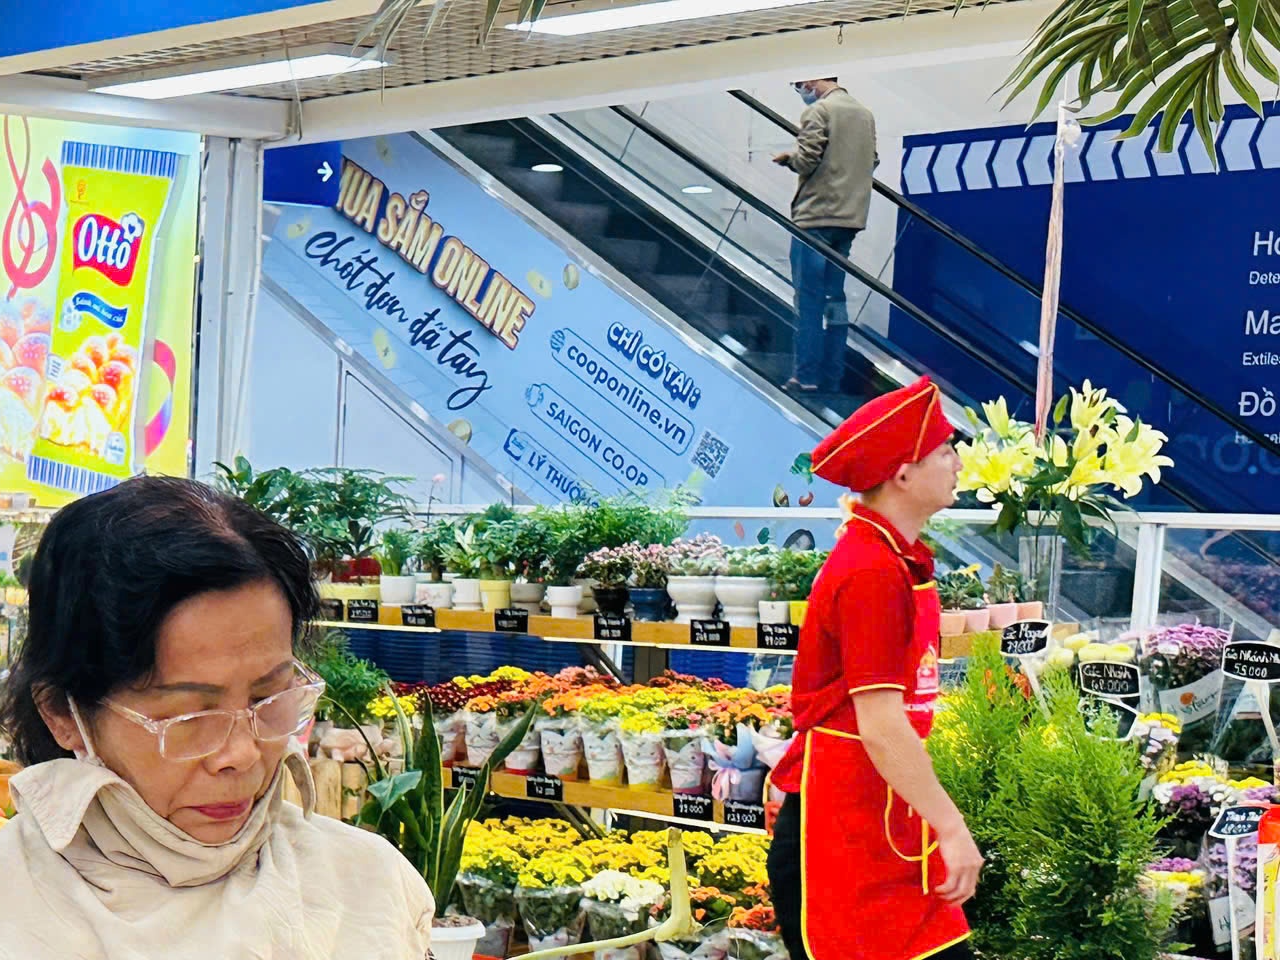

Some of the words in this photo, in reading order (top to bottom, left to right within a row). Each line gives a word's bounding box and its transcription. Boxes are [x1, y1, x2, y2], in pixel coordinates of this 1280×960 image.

[77, 216, 132, 270] Otto
[334, 161, 385, 233] UA
[377, 189, 445, 275] SẮM
[431, 235, 536, 351] ONLINE
[304, 231, 380, 291] Chốt
[363, 272, 409, 323] đơn
[437, 329, 493, 411] tay
[607, 321, 644, 362] CHỈ
[636, 345, 667, 379] CÓ
[567, 345, 687, 445] cooponline.vn
[1238, 387, 1277, 417] Đồ
[527, 451, 547, 473] LÝ
[546, 401, 603, 454] SAIGON
[601, 446, 649, 487] CO.OP
